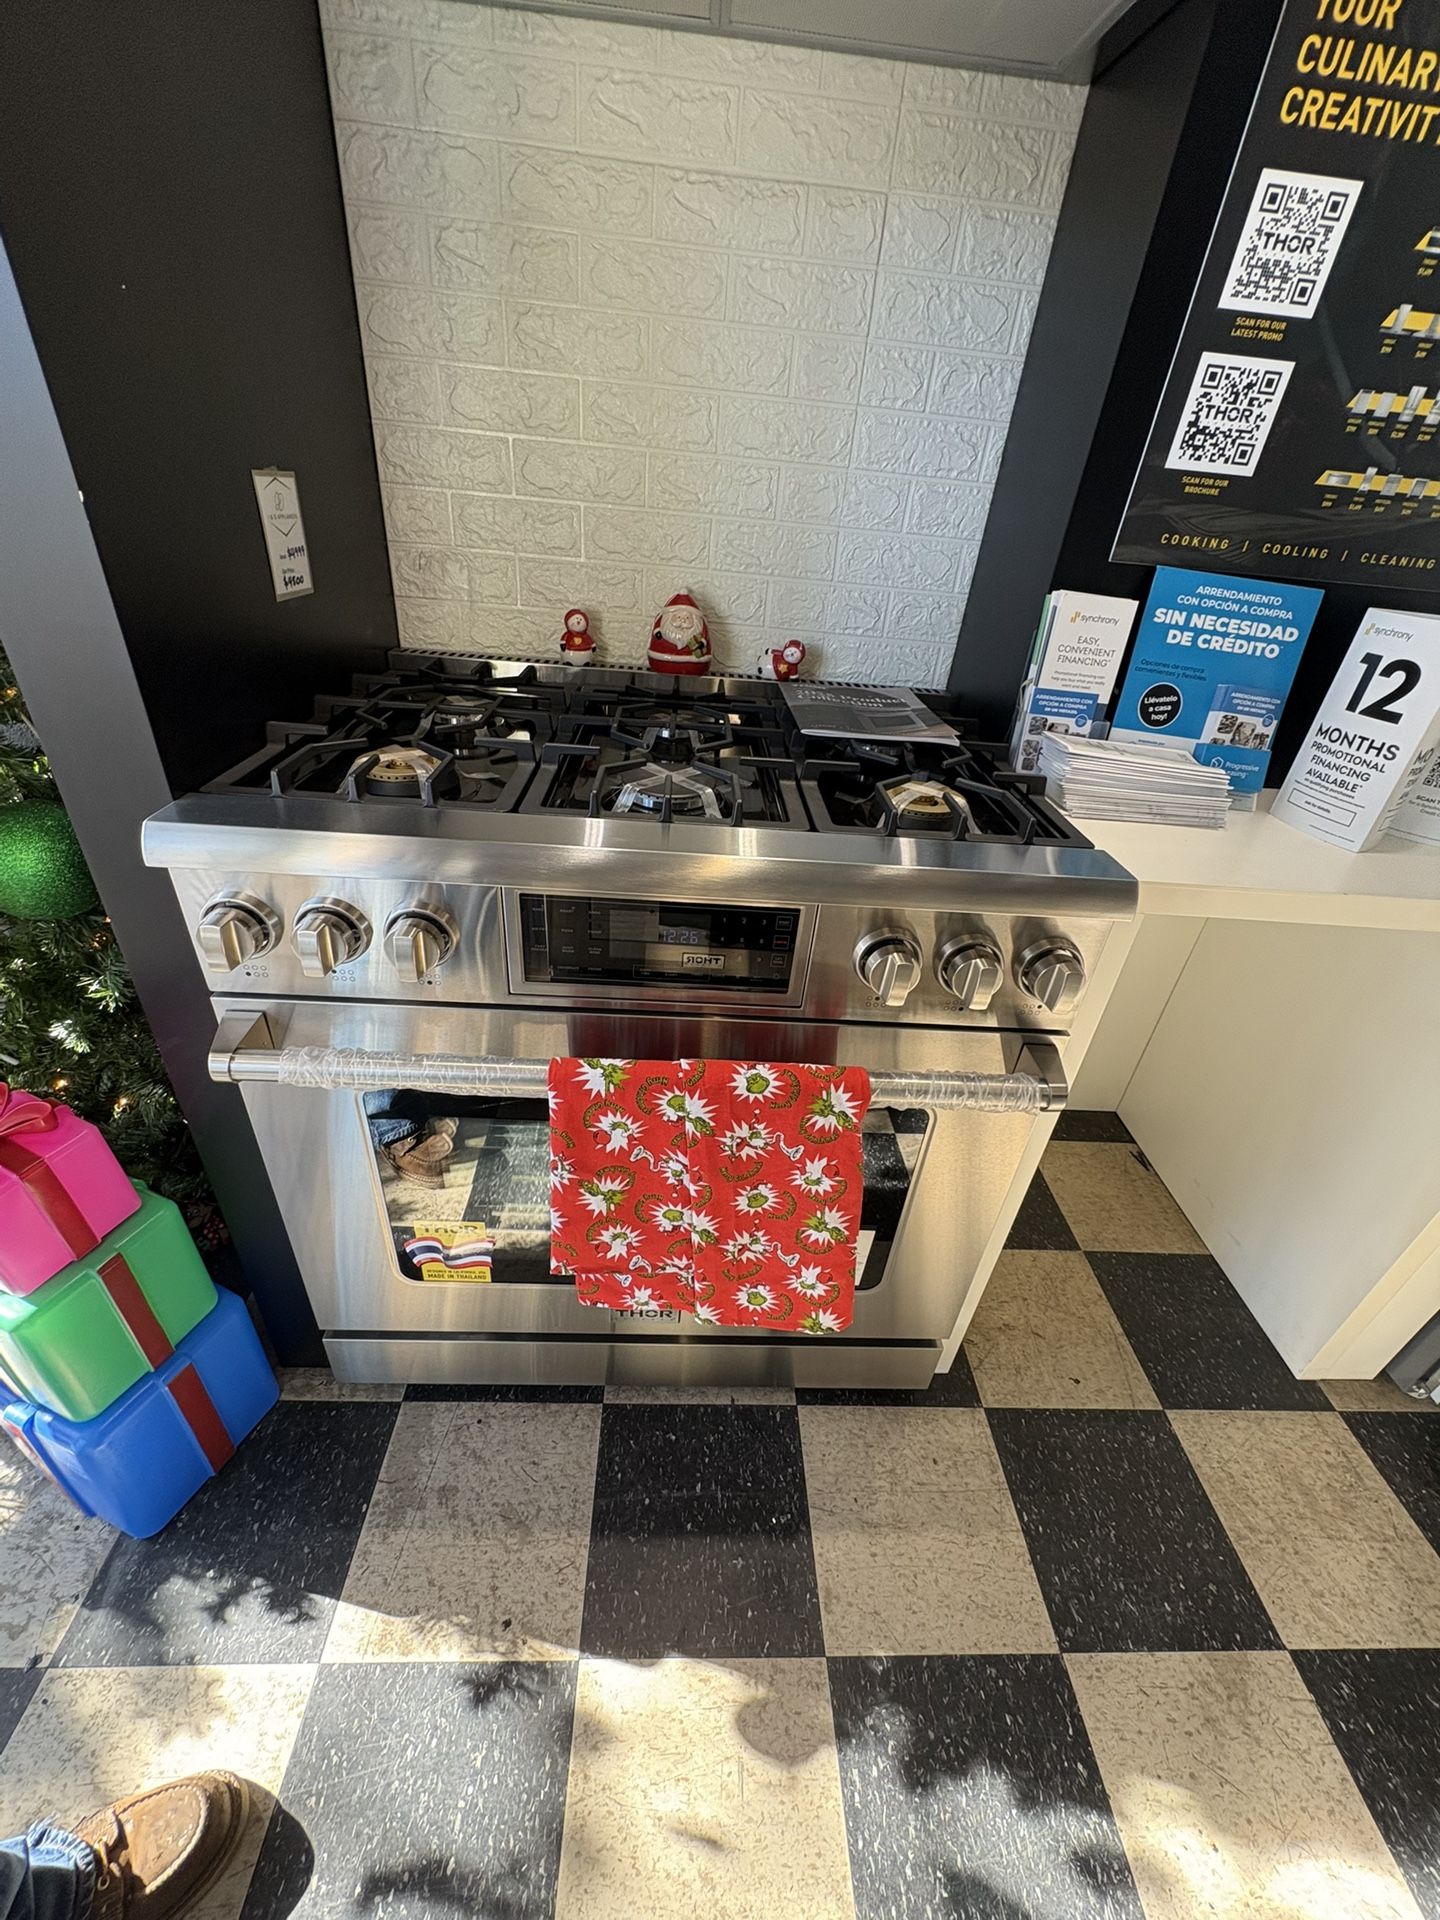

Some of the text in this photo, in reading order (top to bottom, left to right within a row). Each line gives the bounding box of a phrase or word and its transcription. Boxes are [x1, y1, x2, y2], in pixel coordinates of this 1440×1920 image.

[1296, 34, 1440, 94] CULINAR
[1280, 86, 1440, 145] CREATIVIT
[1262, 231, 1316, 254] THOR
[1235, 316, 1288, 330] SCAN FOR OUR
[1231, 328, 1284, 342] LATEST PROMO
[1204, 404, 1253, 424] THOR
[1181, 476, 1200, 484] SCAN
[1214, 480, 1229, 488] OUR
[1184, 486, 1220, 496] BROCHURE
[1160, 533, 1230, 550] COOKING
[1262, 543, 1329, 560] COOLING
[1360, 553, 1436, 569] CLEANING
[1196, 586, 1282, 606] ARRENDAMIENTO
[1177, 595, 1293, 620] CON OPCIÓN A COMPRA
[1080, 614, 1120, 626] synchrony
[1153, 608, 1299, 642] SIN NECESIDAD
[1077, 636, 1100, 647] EASY,
[1166, 630, 1195, 646] DE
[1372, 627, 1414, 642] synchrony
[1057, 644, 1116, 658] CONVENIENT
[1345, 652, 1422, 724] 12
[1144, 695, 1178, 704] Llévatelo
[1315, 722, 1400, 761] MONTHS
[1225, 761, 1260, 772] Progressive
[1310, 741, 1386, 774] PROMOTIONAL
[1310, 755, 1371, 783] FINANCING
[616, 1309, 673, 1318] THOR
